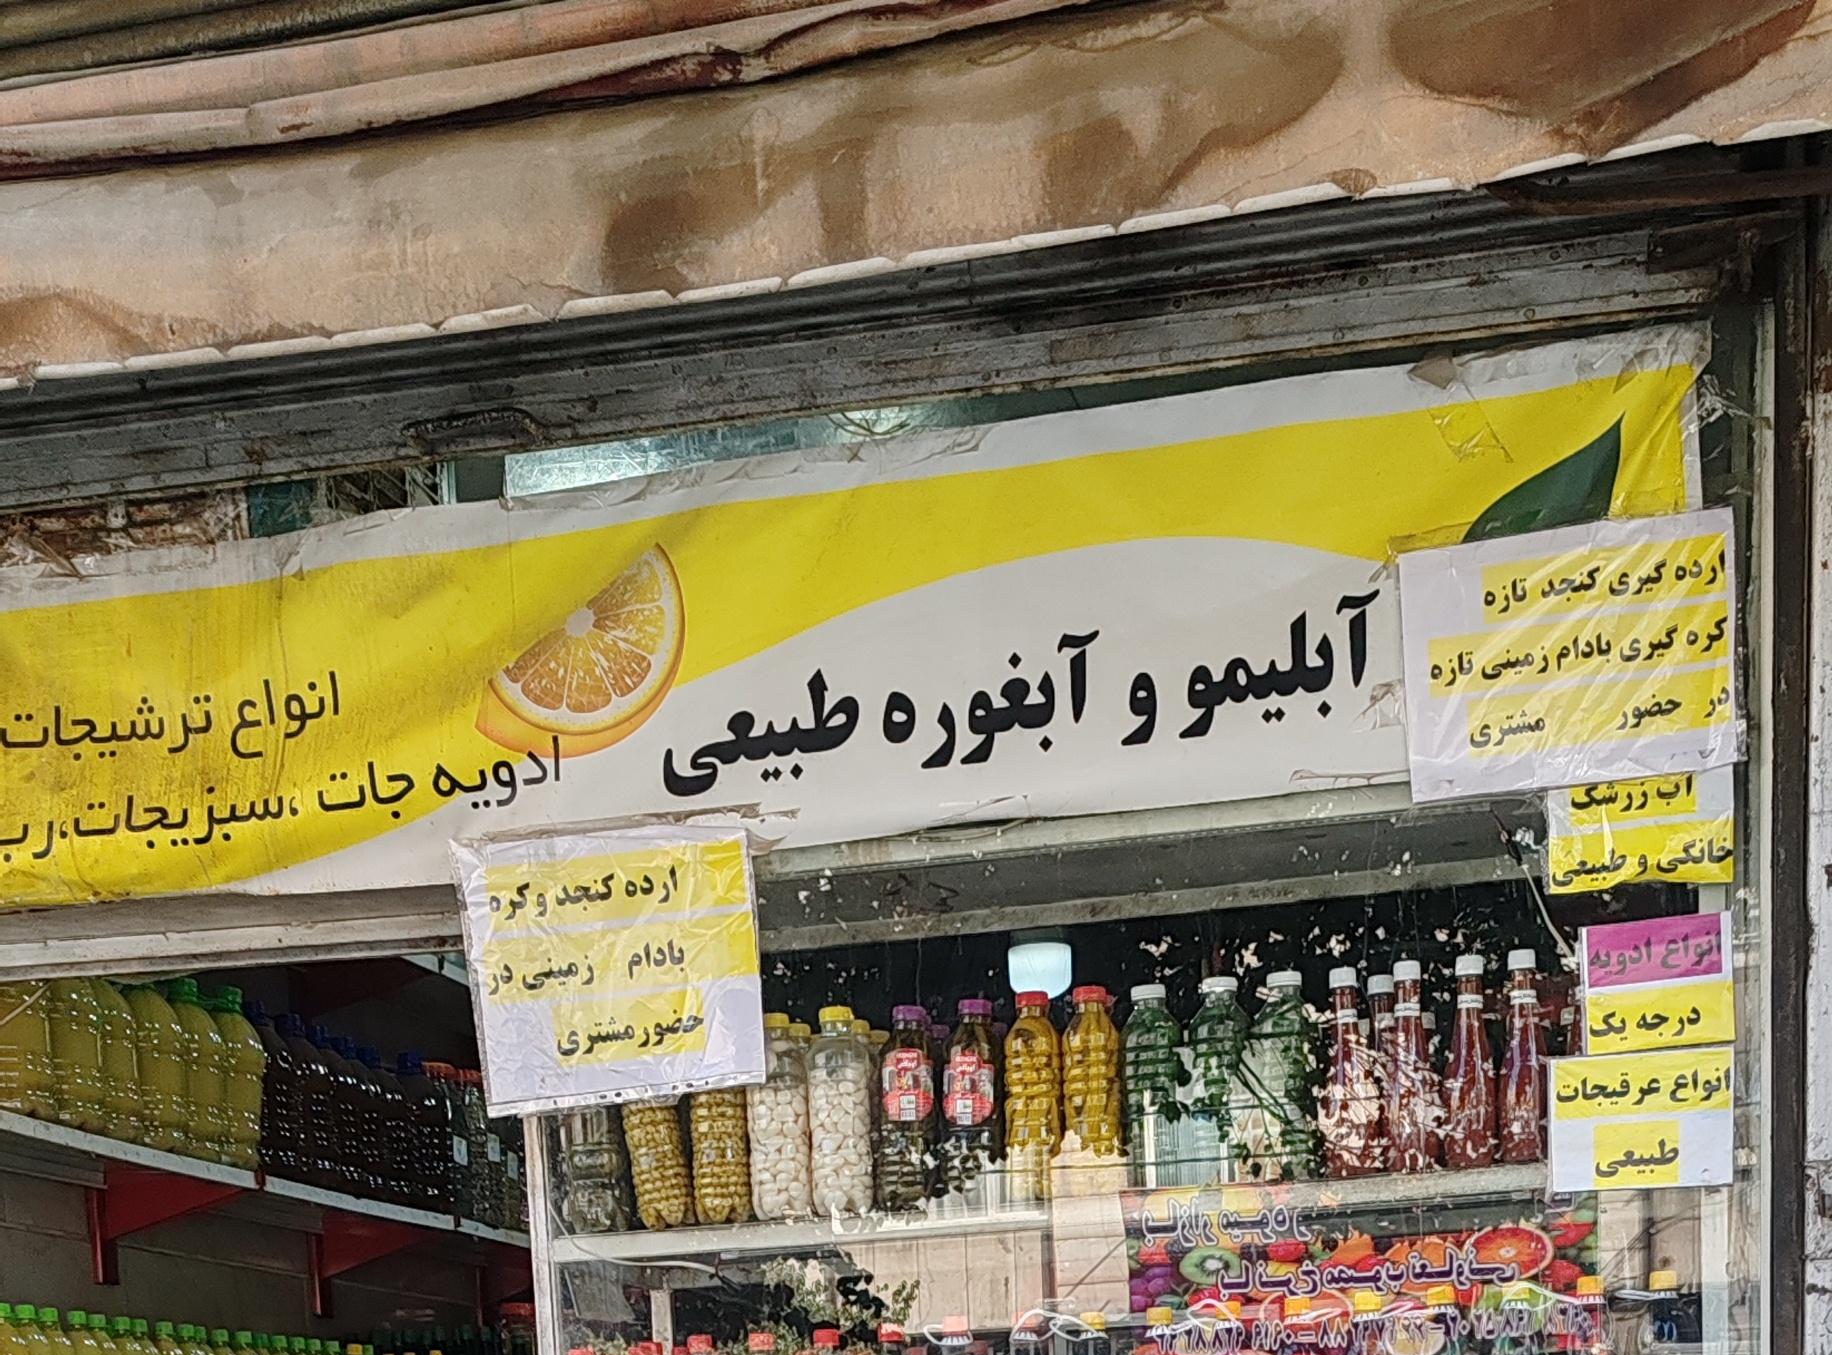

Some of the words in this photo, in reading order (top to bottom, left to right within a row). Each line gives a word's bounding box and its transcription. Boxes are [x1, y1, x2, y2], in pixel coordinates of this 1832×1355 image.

[1540, 566, 1600, 602] کنجد
[1608, 559, 1667, 597] گیری
[1675, 550, 1727, 585] ارده
[1484, 578, 1528, 614] تازه
[1557, 631, 1612, 672] بادام
[1620, 624, 1679, 662] گیری
[1686, 615, 1729, 653] کره
[1179, 586, 1381, 740] آبلیمو
[1430, 651, 1474, 687] تازه
[1482, 646, 1550, 681] زمینی
[231, 671, 341, 758] انواع
[884, 631, 1099, 769] آبغوره
[1120, 671, 1159, 746] و
[1616, 694, 1683, 731] حضور
[1704, 686, 1731, 719] در
[0, 693, 213, 759] ترشیجات
[662, 669, 860, 795] طبیعی
[1469, 709, 1547, 749] مشتری
[317, 760, 416, 821] جات
[432, 735, 562, 811] ادویه
[1571, 781, 1649, 813] زرشک
[1552, 847, 1628, 887] طبیعی
[1635, 853, 1648, 876] و
[1656, 837, 1734, 873] خانگی
[556, 873, 615, 912] کنجد
[624, 864, 679, 904] ارده
[627, 939, 686, 980] بادام
[1589, 934, 1653, 976] ادویه
[1660, 927, 1722, 969] انواع
[488, 963, 514, 997] در
[522, 954, 595, 991] زمینی
[557, 1016, 635, 1057] مشتری
[638, 1008, 705, 1048] حضور
[1589, 1010, 1627, 1041] یک
[1636, 1006, 1702, 1037] درجه
[1556, 1072, 1661, 1107] عرقیجات
[1669, 1065, 1731, 1102] انواع
[1595, 1138, 1680, 1177] طبیعی
